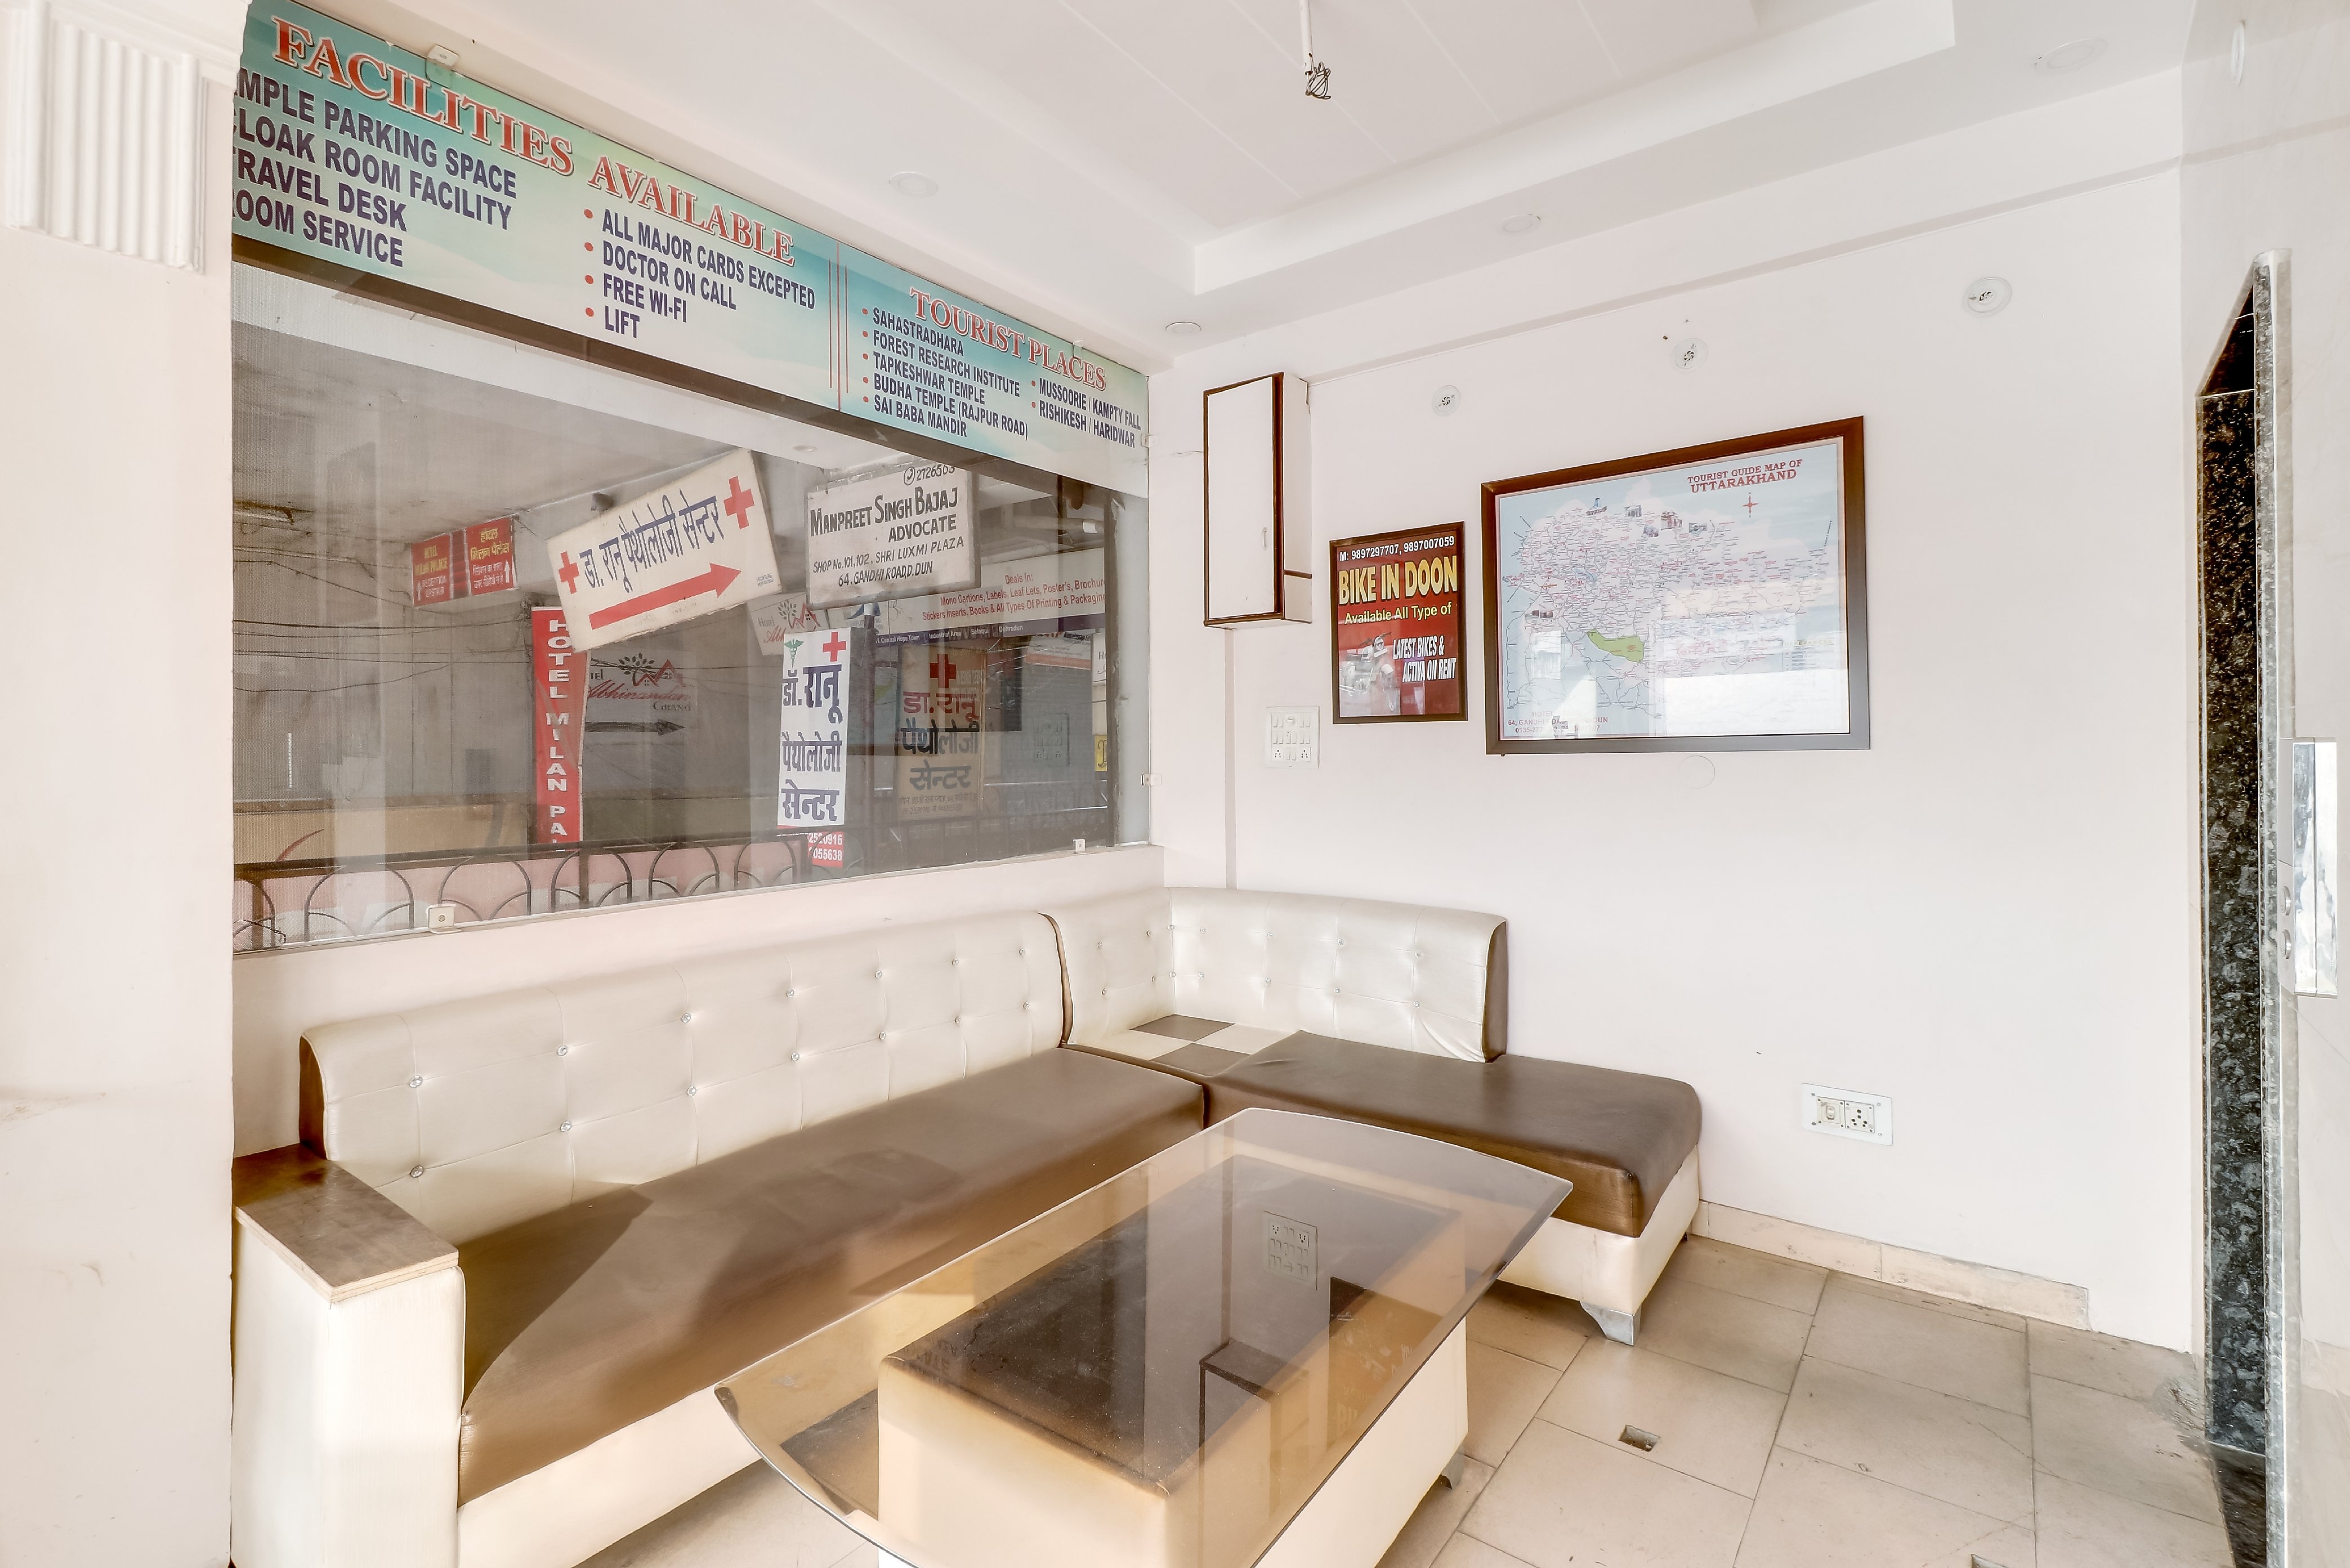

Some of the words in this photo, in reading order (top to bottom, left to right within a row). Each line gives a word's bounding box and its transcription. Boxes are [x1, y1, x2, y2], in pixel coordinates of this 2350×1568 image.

[234, 67, 315, 124] MPLE
[324, 100, 437, 168] PARKING
[445, 147, 517, 199] SPACE
[271, 16, 574, 176] FACILITIES
[587, 155, 796, 266] AVAILABLE
[233, 108, 316, 164] LOAK
[325, 139, 401, 193] ROOM
[410, 170, 512, 230] FACILITY
[233, 145, 329, 207] RAVEL
[338, 181, 406, 232] DESK
[232, 189, 294, 235] OOM
[302, 209, 403, 267] SERVICE
[602, 209, 633, 242] ALL
[638, 221, 692, 265] MAJOR
[697, 246, 744, 284] CARDS
[749, 266, 815, 309] EXCEPTED
[603, 240, 669, 286] DOCTOR
[674, 270, 695, 296] ON
[700, 278, 737, 310] CALL
[603, 273, 645, 309] FREE
[649, 288, 687, 323] WI-FI
[605, 305, 640, 338] LIFT
[873, 307, 964, 356] SAHASTRADHARA
[910, 287, 1025, 358] TOURIST
[1028, 338, 1106, 391] PLACES
[873, 329, 915, 359] FOREST
[918, 346, 970, 379] RESEARCH
[973, 366, 1020, 397] INSTITUTE
[873, 351, 945, 391] TAPKESHWAR
[948, 377, 985, 405] TEMPLE
[874, 373, 912, 400] BUDHA
[915, 387, 955, 414] TEMPLE
[959, 401, 999, 428] (RAJPUR
[1002, 416, 1028, 441] ROAD)
[874, 394, 892, 415] SAI
[896, 402, 924, 425] BABA
[928, 412, 967, 437] MANDIR
[1039, 378, 1087, 410] MUSSOORIE
[1093, 398, 1123, 423] KAMPTY
[1125, 409, 1141, 430] FALL
[1039, 400, 1087, 431] RISHIKESH
[1093, 419, 1135, 448] HARIDWAR
[1687, 471, 1728, 484] TOURIST
[1731, 466, 1762, 476] GUIDE
[1764, 462, 1786, 472] MAP
[1789, 459, 1803, 468] OF
[1691, 469, 1797, 493] UTTARAKHAND
[810, 506, 872, 537] MANPREET
[874, 495, 912, 524] SINGH
[915, 486, 958, 516] BAJAJ
[888, 514, 957, 543] ADVOCATE
[813, 560, 832, 573] SHOP
[875, 550, 895, 563] SHRI
[897, 544, 928, 560] LUXMI
[931, 536, 964, 553] PLAZA
[1339, 551, 1350, 562] M:
[1404, 536, 1455, 553] 9897007059
[854, 568, 884, 584] GANDHI
[941, 596, 957, 606] Mono
[986, 589, 1009, 600] Labels,
[1010, 587, 1024, 597] Leaf
[1005, 574, 1023, 584] Deals
[1339, 566, 1377, 605] BIKE
[1381, 562, 1400, 600] IN
[1405, 556, 1458, 597] DOON
[923, 610, 945, 620] Stickers
[970, 605, 989, 615] Books
[990, 604, 995, 613] &
[1006, 602, 1025, 614] Types
[1026, 599, 1034, 609] Of
[1036, 597, 1062, 609] Printing
[1064, 595, 1069, 605] &
[1344, 609, 1392, 624] Available
[1394, 606, 1409, 620] All
[1411, 605, 1437, 620] Type
[1441, 601, 1452, 615] of
[547, 619, 572, 699] HOTEL
[1393, 638, 1417, 660] LATEST
[1417, 635, 1438, 658] BIKES
[1438, 635, 1445, 656] &
[1402, 661, 1426, 682] ACTIVA
[1427, 660, 1437, 681] ON
[1438, 658, 1457, 680] RENT
[546, 713, 570, 792] MILAN
